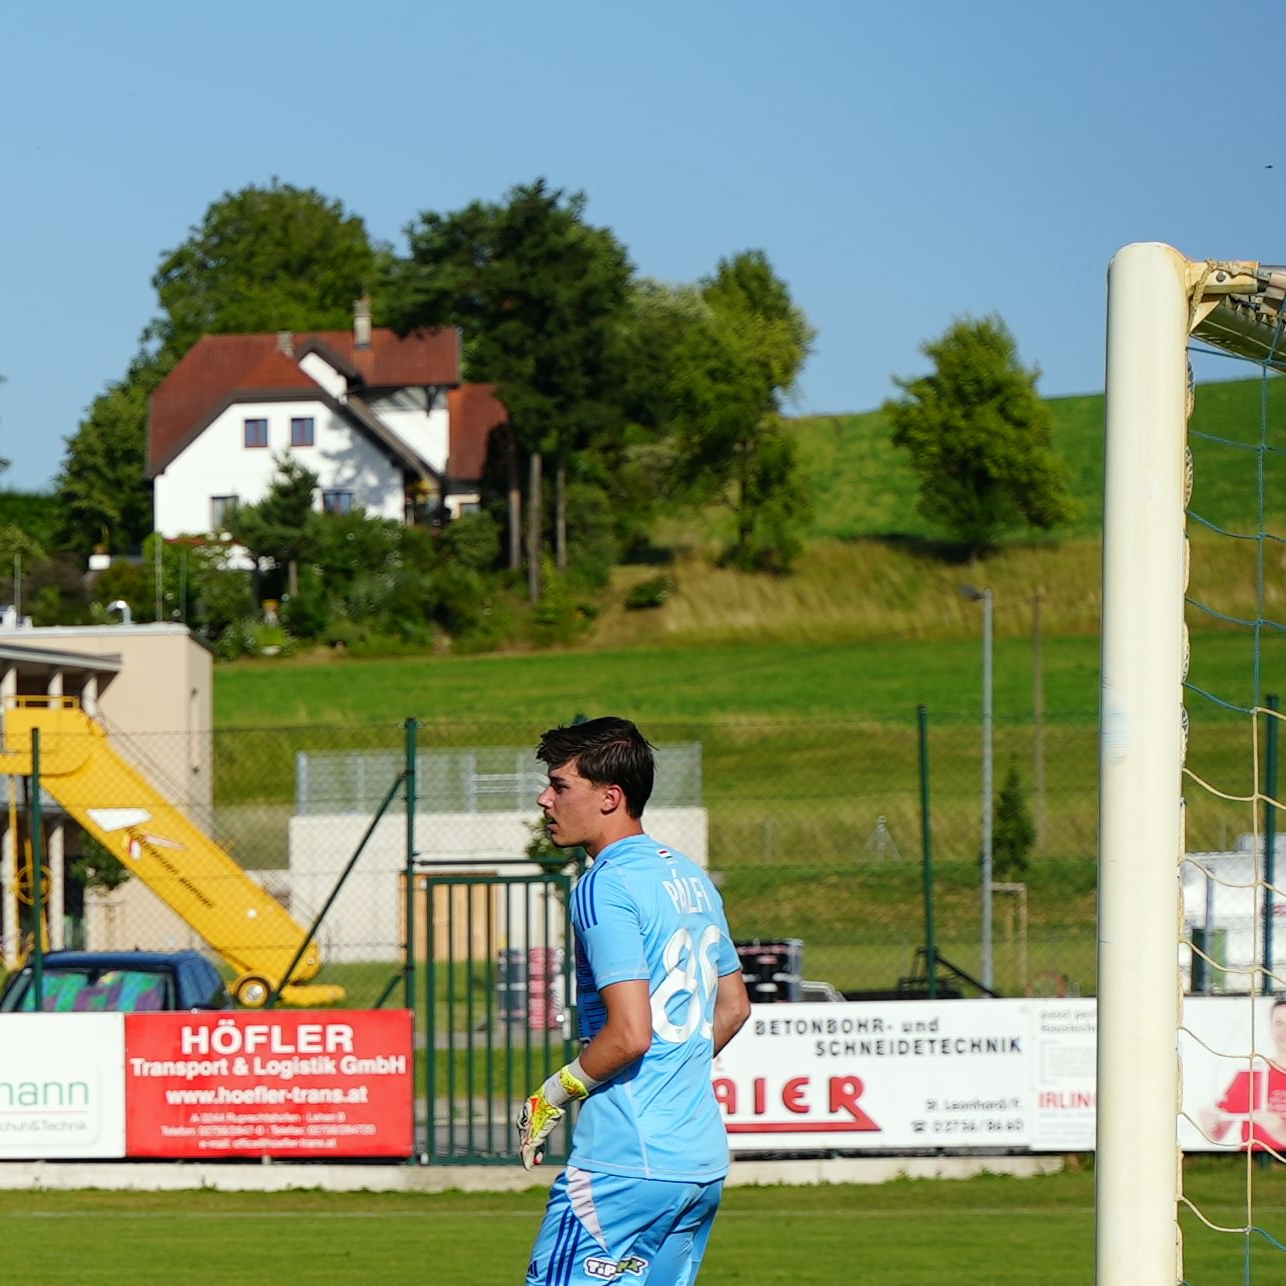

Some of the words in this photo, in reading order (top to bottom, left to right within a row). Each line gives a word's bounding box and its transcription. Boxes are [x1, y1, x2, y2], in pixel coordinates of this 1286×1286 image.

[181, 1019, 354, 1055] HÖFLER
[755, 1019, 893, 1035] BETONBOHR-
[902, 1017, 939, 1033] und
[815, 1037, 1022, 1056] SCHNEIDETECHNIK
[130, 1057, 229, 1080] Transport
[233, 1057, 249, 1076] &
[254, 1056, 337, 1079] Logistik
[340, 1055, 406, 1075] GmbH
[712, 1075, 873, 1122] AIER
